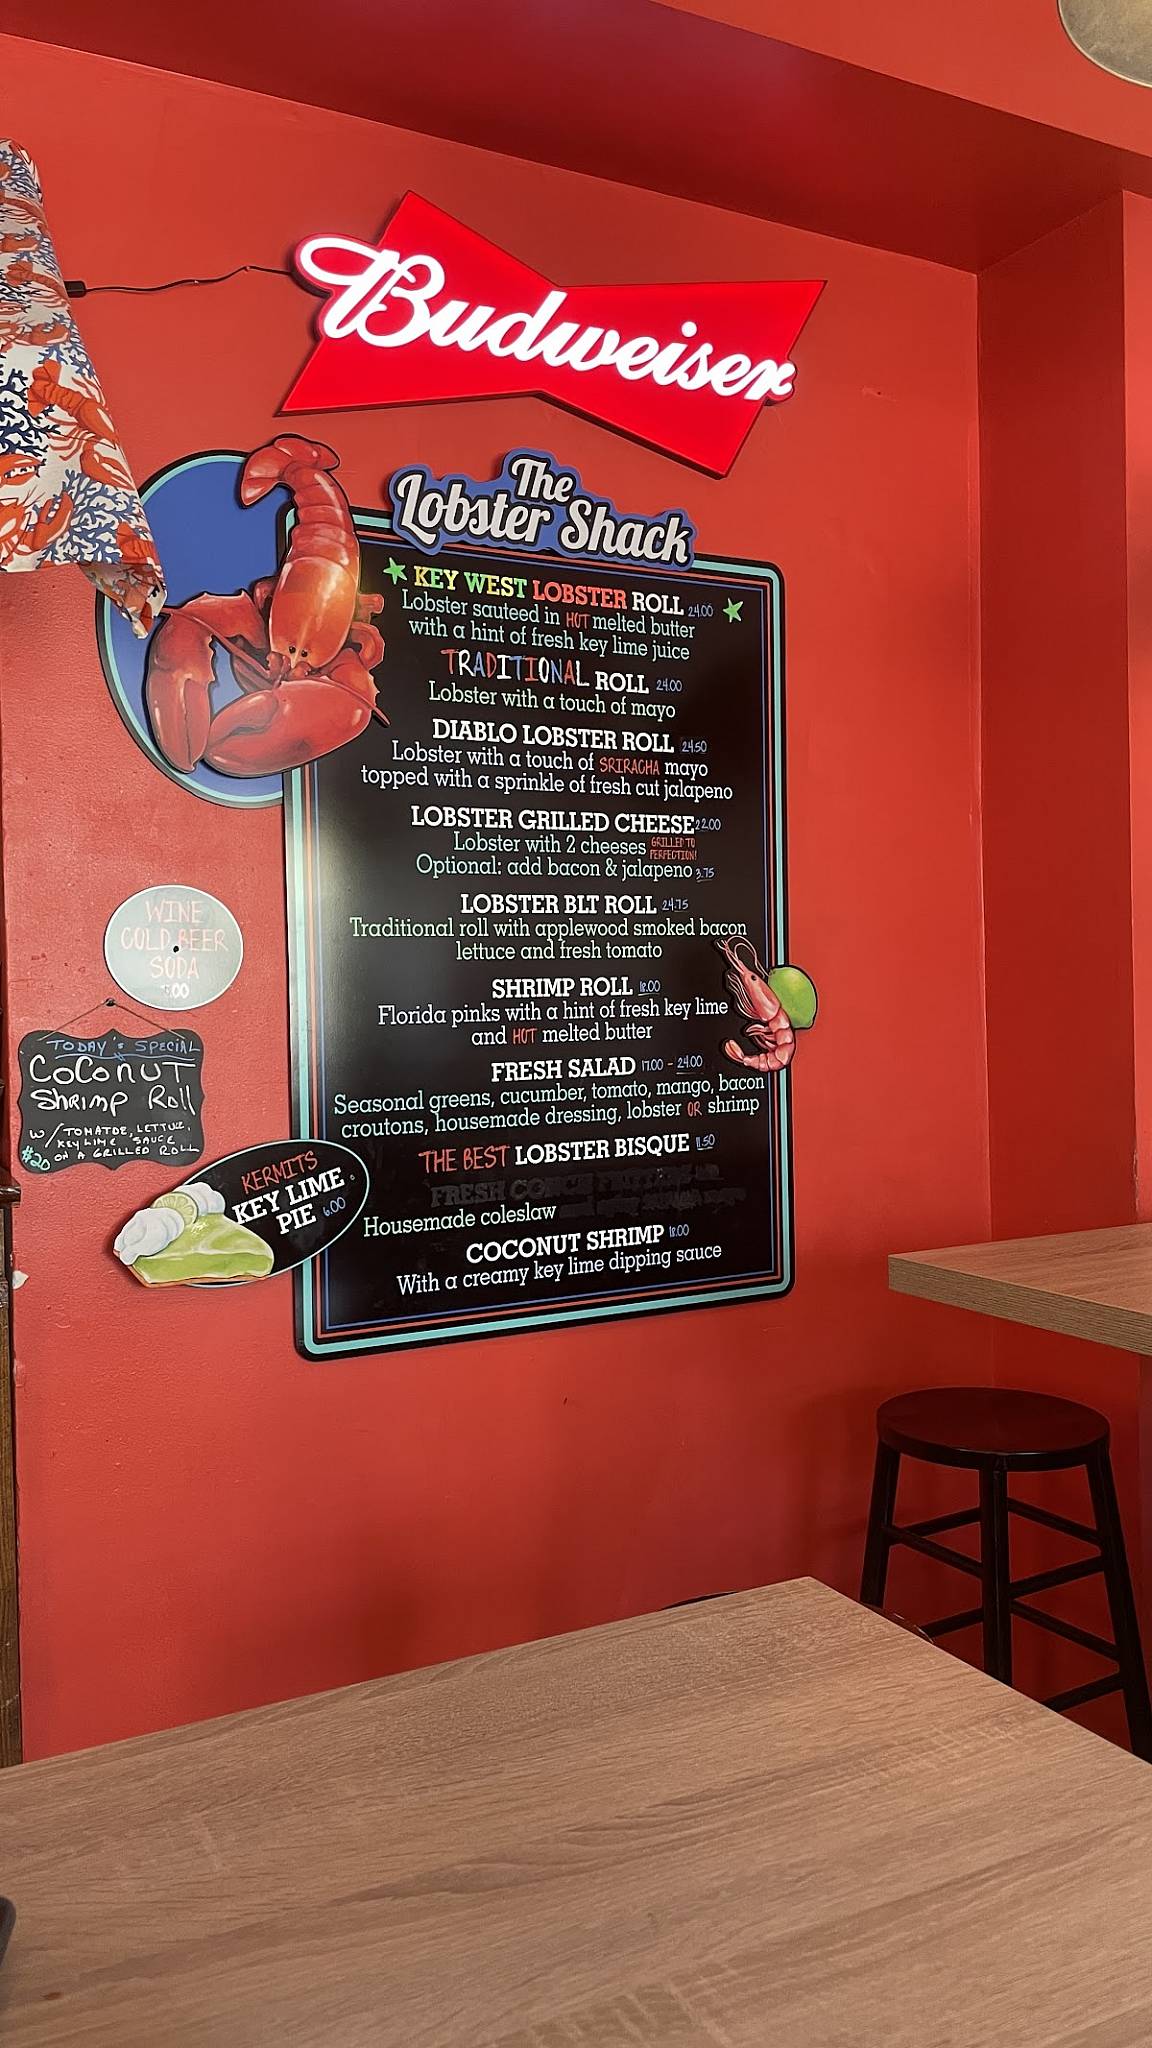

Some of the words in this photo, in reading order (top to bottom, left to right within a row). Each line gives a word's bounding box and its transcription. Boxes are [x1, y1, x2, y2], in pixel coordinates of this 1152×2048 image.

[299, 237, 795, 400] Budweiser
[512, 458, 573, 502] The
[397, 474, 550, 544] Lobster
[561, 500, 690, 563] Shack
[414, 566, 459, 590] KEY
[464, 572, 527, 598] WEST
[533, 580, 627, 609] LOBSTER
[632, 592, 684, 615] ROLL
[688, 604, 713, 617] 24.00
[402, 589, 468, 615] Lobster
[473, 603, 539, 623] sauteed
[545, 606, 560, 625] in
[567, 612, 590, 628] HOT
[593, 613, 646, 633] melted
[651, 616, 695, 638] butter
[409, 617, 448, 637] with
[453, 625, 465, 638] a
[471, 620, 504, 642] hint
[510, 626, 526, 644] of
[532, 627, 574, 649] fresh
[579, 632, 608, 657] key
[613, 635, 647, 656] lime
[653, 640, 689, 661] juice
[441, 649, 589, 686] TRADITIONAL
[595, 671, 649, 694] ROLL
[657, 679, 682, 691] 24.00
[429, 681, 497, 705] Lobster
[501, 689, 538, 708] with
[544, 696, 554, 709] a
[559, 694, 606, 713] touch
[611, 696, 626, 714] of
[631, 703, 675, 722] mayo
[433, 719, 517, 743] DIABLO
[522, 725, 617, 749] LOBSTER
[622, 732, 674, 753] ROLL
[682, 740, 706, 752] 24.50
[392, 740, 462, 763] Lobster
[467, 746, 504, 766] with
[510, 754, 521, 766] a
[526, 751, 573, 769] touch
[578, 752, 594, 770] of
[600, 757, 659, 775] SRIRACHA
[665, 763, 708, 781] mayo
[361, 765, 429, 789] topped
[434, 768, 472, 787] with
[478, 775, 489, 788] a
[495, 772, 564, 794] sprinkle
[569, 775, 585, 792] of
[590, 775, 631, 795] fresh
[636, 780, 659, 796] cut
[664, 779, 732, 802] jalapeno
[411, 806, 513, 828] LOBSTER
[615, 813, 694, 834] CHEESE
[695, 818, 721, 830] 22.00
[454, 831, 520, 851] Lobster
[525, 834, 561, 852] with
[567, 835, 575, 853] 2
[581, 835, 646, 854] cheeses
[417, 854, 501, 878] Optional:
[508, 856, 542, 875] add
[547, 857, 600, 876] bacon
[606, 858, 617, 876] &
[622, 859, 692, 881] jalapeno
[146, 901, 205, 923] WINE
[461, 894, 559, 914] LOBSTER
[564, 895, 599, 913] BLT
[604, 895, 657, 914] ROLL
[662, 898, 688, 912] 24.75
[121, 927, 171, 950] COLD
[178, 928, 228, 951] BEER
[349, 917, 454, 937] Traditional
[460, 918, 489, 936] roll
[493, 918, 530, 936] with
[535, 917, 628, 943] applewood
[634, 918, 695, 935] smoked
[700, 918, 747, 935] bacon
[150, 956, 200, 979] SODA
[456, 941, 515, 960] lettuce
[520, 940, 556, 960] and
[558, 940, 602, 959] fresh
[606, 942, 662, 958] tomato
[492, 978, 575, 998] SHRIMP
[580, 977, 633, 996] ROLL
[378, 1004, 446, 1024] Florida
[451, 1003, 500, 1028] pinks
[505, 1001, 541, 1021] with
[547, 1007, 558, 1019] a
[563, 1001, 594, 1019] hint
[600, 999, 615, 1018] of
[620, 999, 660, 1017] fresh
[664, 998, 691, 1020] key
[695, 997, 728, 1015] lime
[472, 1025, 507, 1045] and
[513, 1028, 537, 1044] HOT
[542, 1022, 600, 1042] melted
[605, 1022, 653, 1040] butter
[491, 1060, 562, 1082] FRESH
[568, 1057, 636, 1078] SALAD
[678, 1055, 702, 1068] 24.00
[335, 1090, 424, 1114] Seasonal
[429, 1089, 495, 1115] greens,
[501, 1083, 586, 1104] cucumber,
[592, 1081, 651, 1099] tomato,
[657, 1081, 713, 1097] mango,
[719, 1074, 764, 1091] bacon
[342, 1118, 428, 1138] croutons,
[434, 1108, 540, 1134] housemade
[545, 1104, 621, 1125] dressing,
[627, 1100, 681, 1119] lobster
[688, 1101, 702, 1116] OR
[708, 1096, 759, 1115] shrimp
[55, 1152, 68, 1161] ON
[160, 1144, 199, 1156] ROLL
[57, 1139, 79, 1149] KEY
[85, 1138, 116, 1146] LIME
[133, 1135, 175, 1144] SAUCE
[418, 1149, 456, 1173] THE
[464, 1145, 510, 1170] BEST
[515, 1140, 610, 1165] LOBSTER
[615, 1133, 689, 1157] BISQUE
[242, 1151, 318, 1194] KERMITS
[232, 1190, 279, 1224] KEY
[285, 1167, 345, 1206] LIME
[276, 1204, 316, 1234] PIE
[323, 1197, 345, 1216] 6.00
[364, 1209, 475, 1237] Housemade
[481, 1202, 556, 1225] coleslaw
[465, 1233, 581, 1264] COCONUT
[587, 1225, 664, 1250] SHRIMP
[397, 1272, 440, 1295] With
[445, 1276, 457, 1289] a
[463, 1268, 529, 1287] creamy
[534, 1261, 564, 1282] key
[568, 1256, 604, 1275] lime
[609, 1249, 671, 1273] dipping
[677, 1246, 721, 1262] sauce
